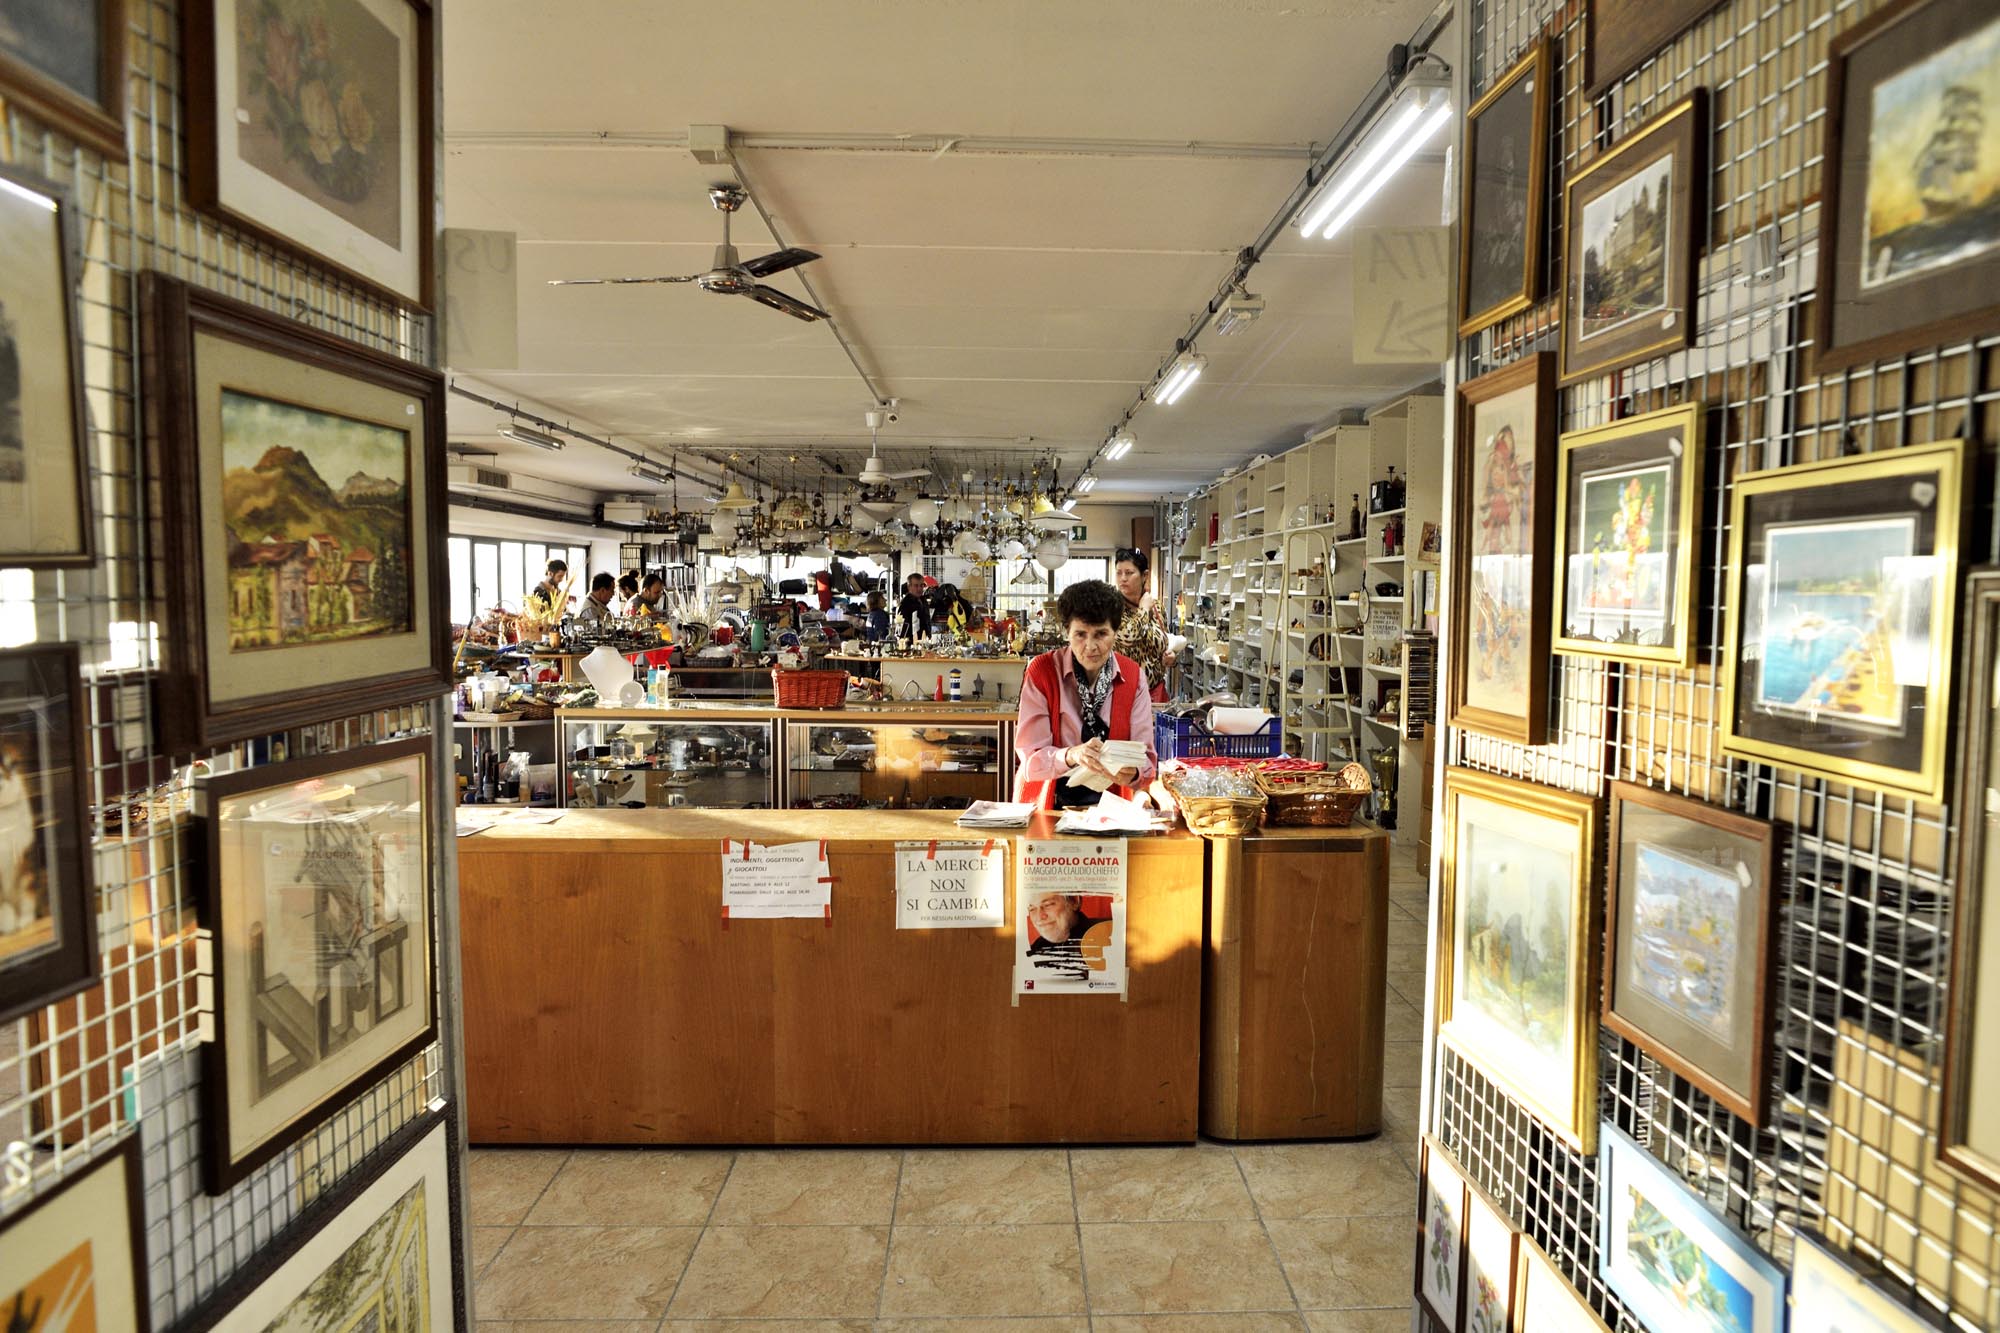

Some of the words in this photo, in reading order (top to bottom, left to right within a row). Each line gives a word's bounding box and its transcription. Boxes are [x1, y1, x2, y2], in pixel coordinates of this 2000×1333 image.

[907, 860, 927, 872] LA
[935, 859, 988, 872] MERCE
[1024, 857, 1034, 866] IL
[1036, 857, 1080, 866] POPOLO
[1083, 857, 1119, 866] CANTA
[1024, 866, 1057, 875] OMAGGIO
[1064, 866, 1091, 875] CLAUDIO
[930, 879, 966, 891] NON
[906, 899, 919, 911] SI
[927, 898, 989, 911] CAMBIA
